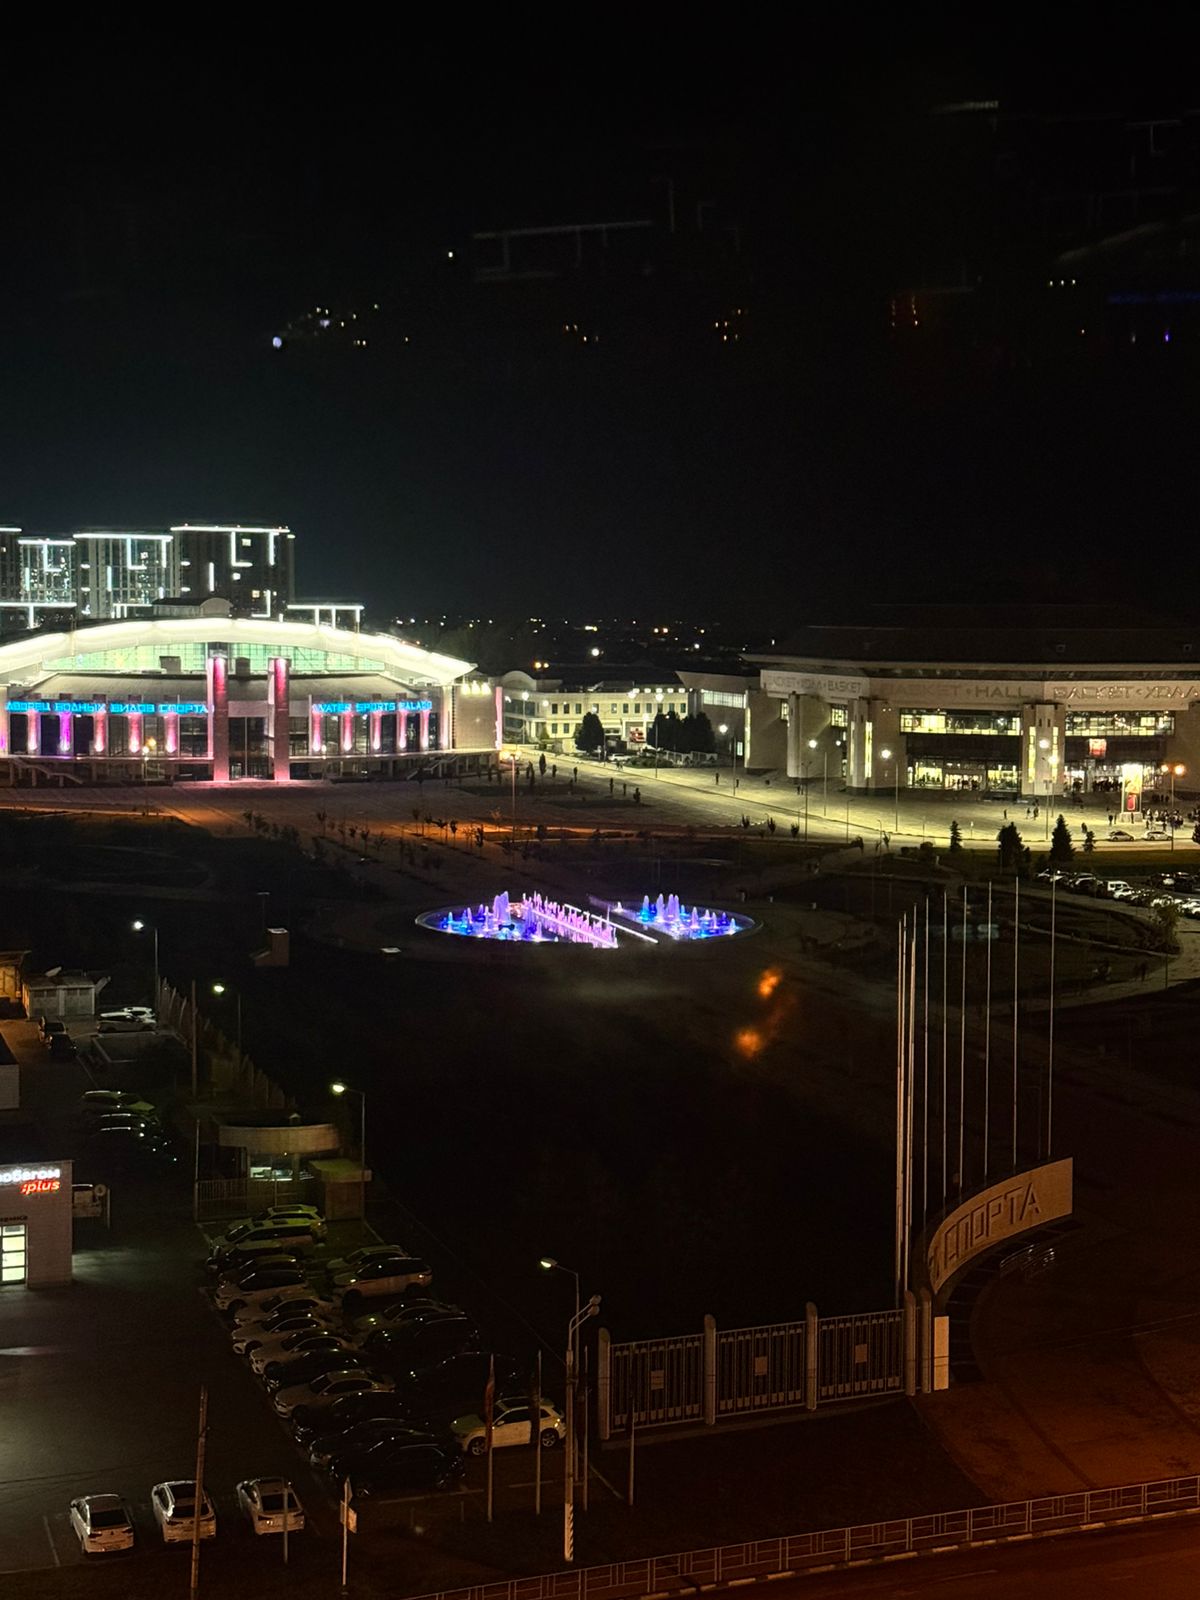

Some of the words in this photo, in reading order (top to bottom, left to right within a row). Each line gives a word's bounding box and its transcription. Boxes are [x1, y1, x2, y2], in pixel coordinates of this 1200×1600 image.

[975, 685, 1031, 699] HALL
[7, 701, 51, 712] ДВОРЕЦ
[55, 702, 106, 713] ВОДНЫХ
[110, 703, 154, 713] ВИДОВ
[158, 703, 209, 713] СПОРТА
[312, 703, 352, 713] WATER
[356, 702, 395, 712] SPORTS
[0, 1168, 60, 1183] обегом
